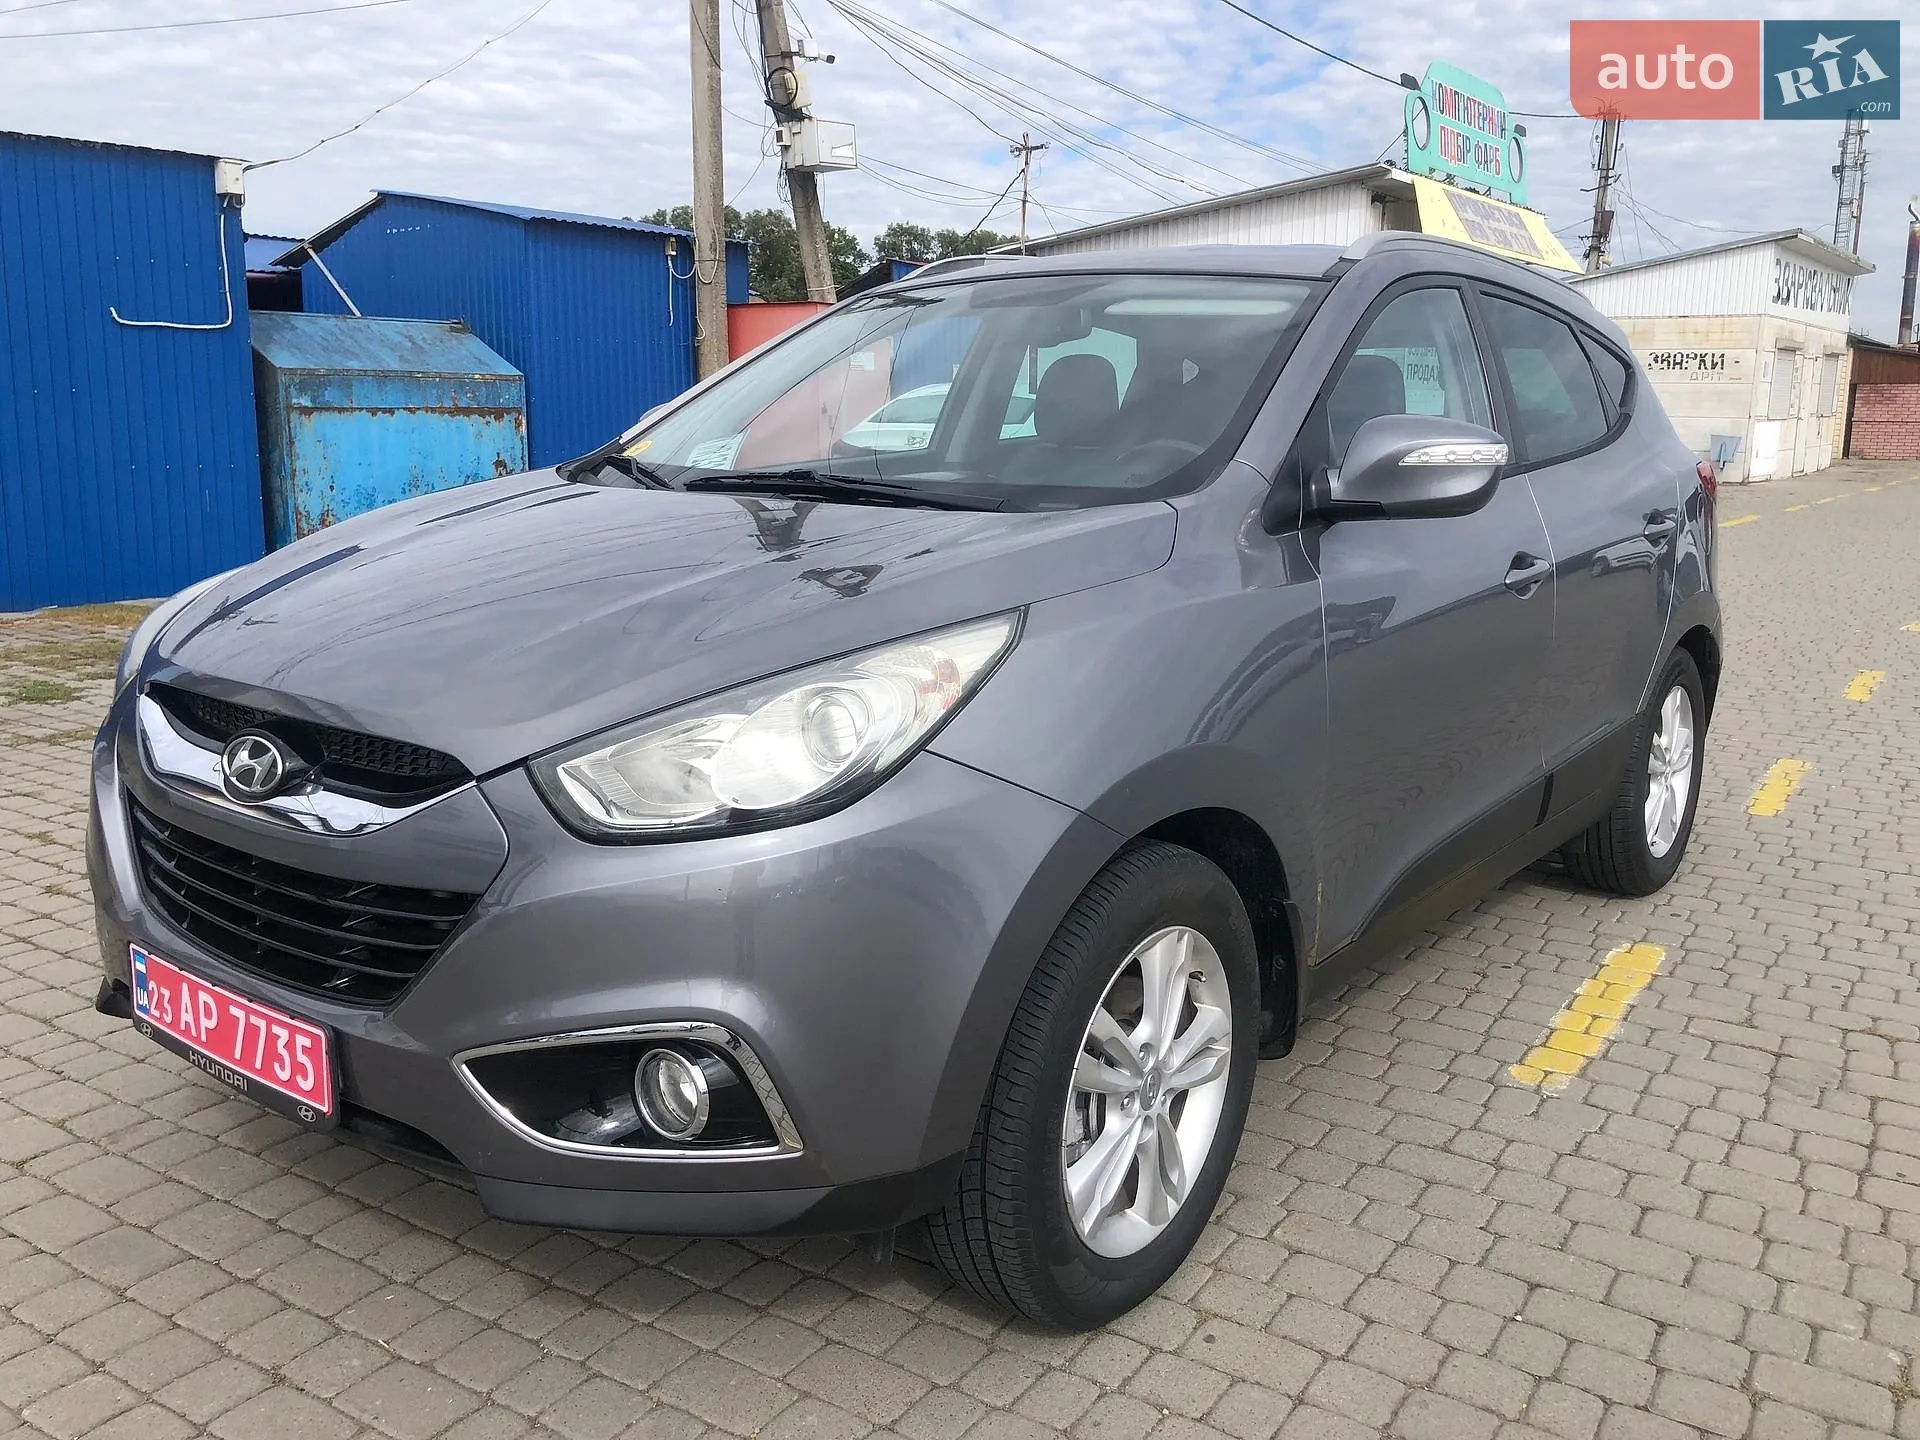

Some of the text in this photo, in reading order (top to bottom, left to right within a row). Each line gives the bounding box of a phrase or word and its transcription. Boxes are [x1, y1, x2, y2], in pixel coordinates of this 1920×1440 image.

[1439, 125, 1501, 176] ПІДБІР ФАРБ
[1647, 351, 1725, 371] ЗВАРКИ
[137, 986, 150, 1009] UA
[149, 980, 315, 1092] 23 AP 7735
[189, 1050, 249, 1091] HYUNDAI
